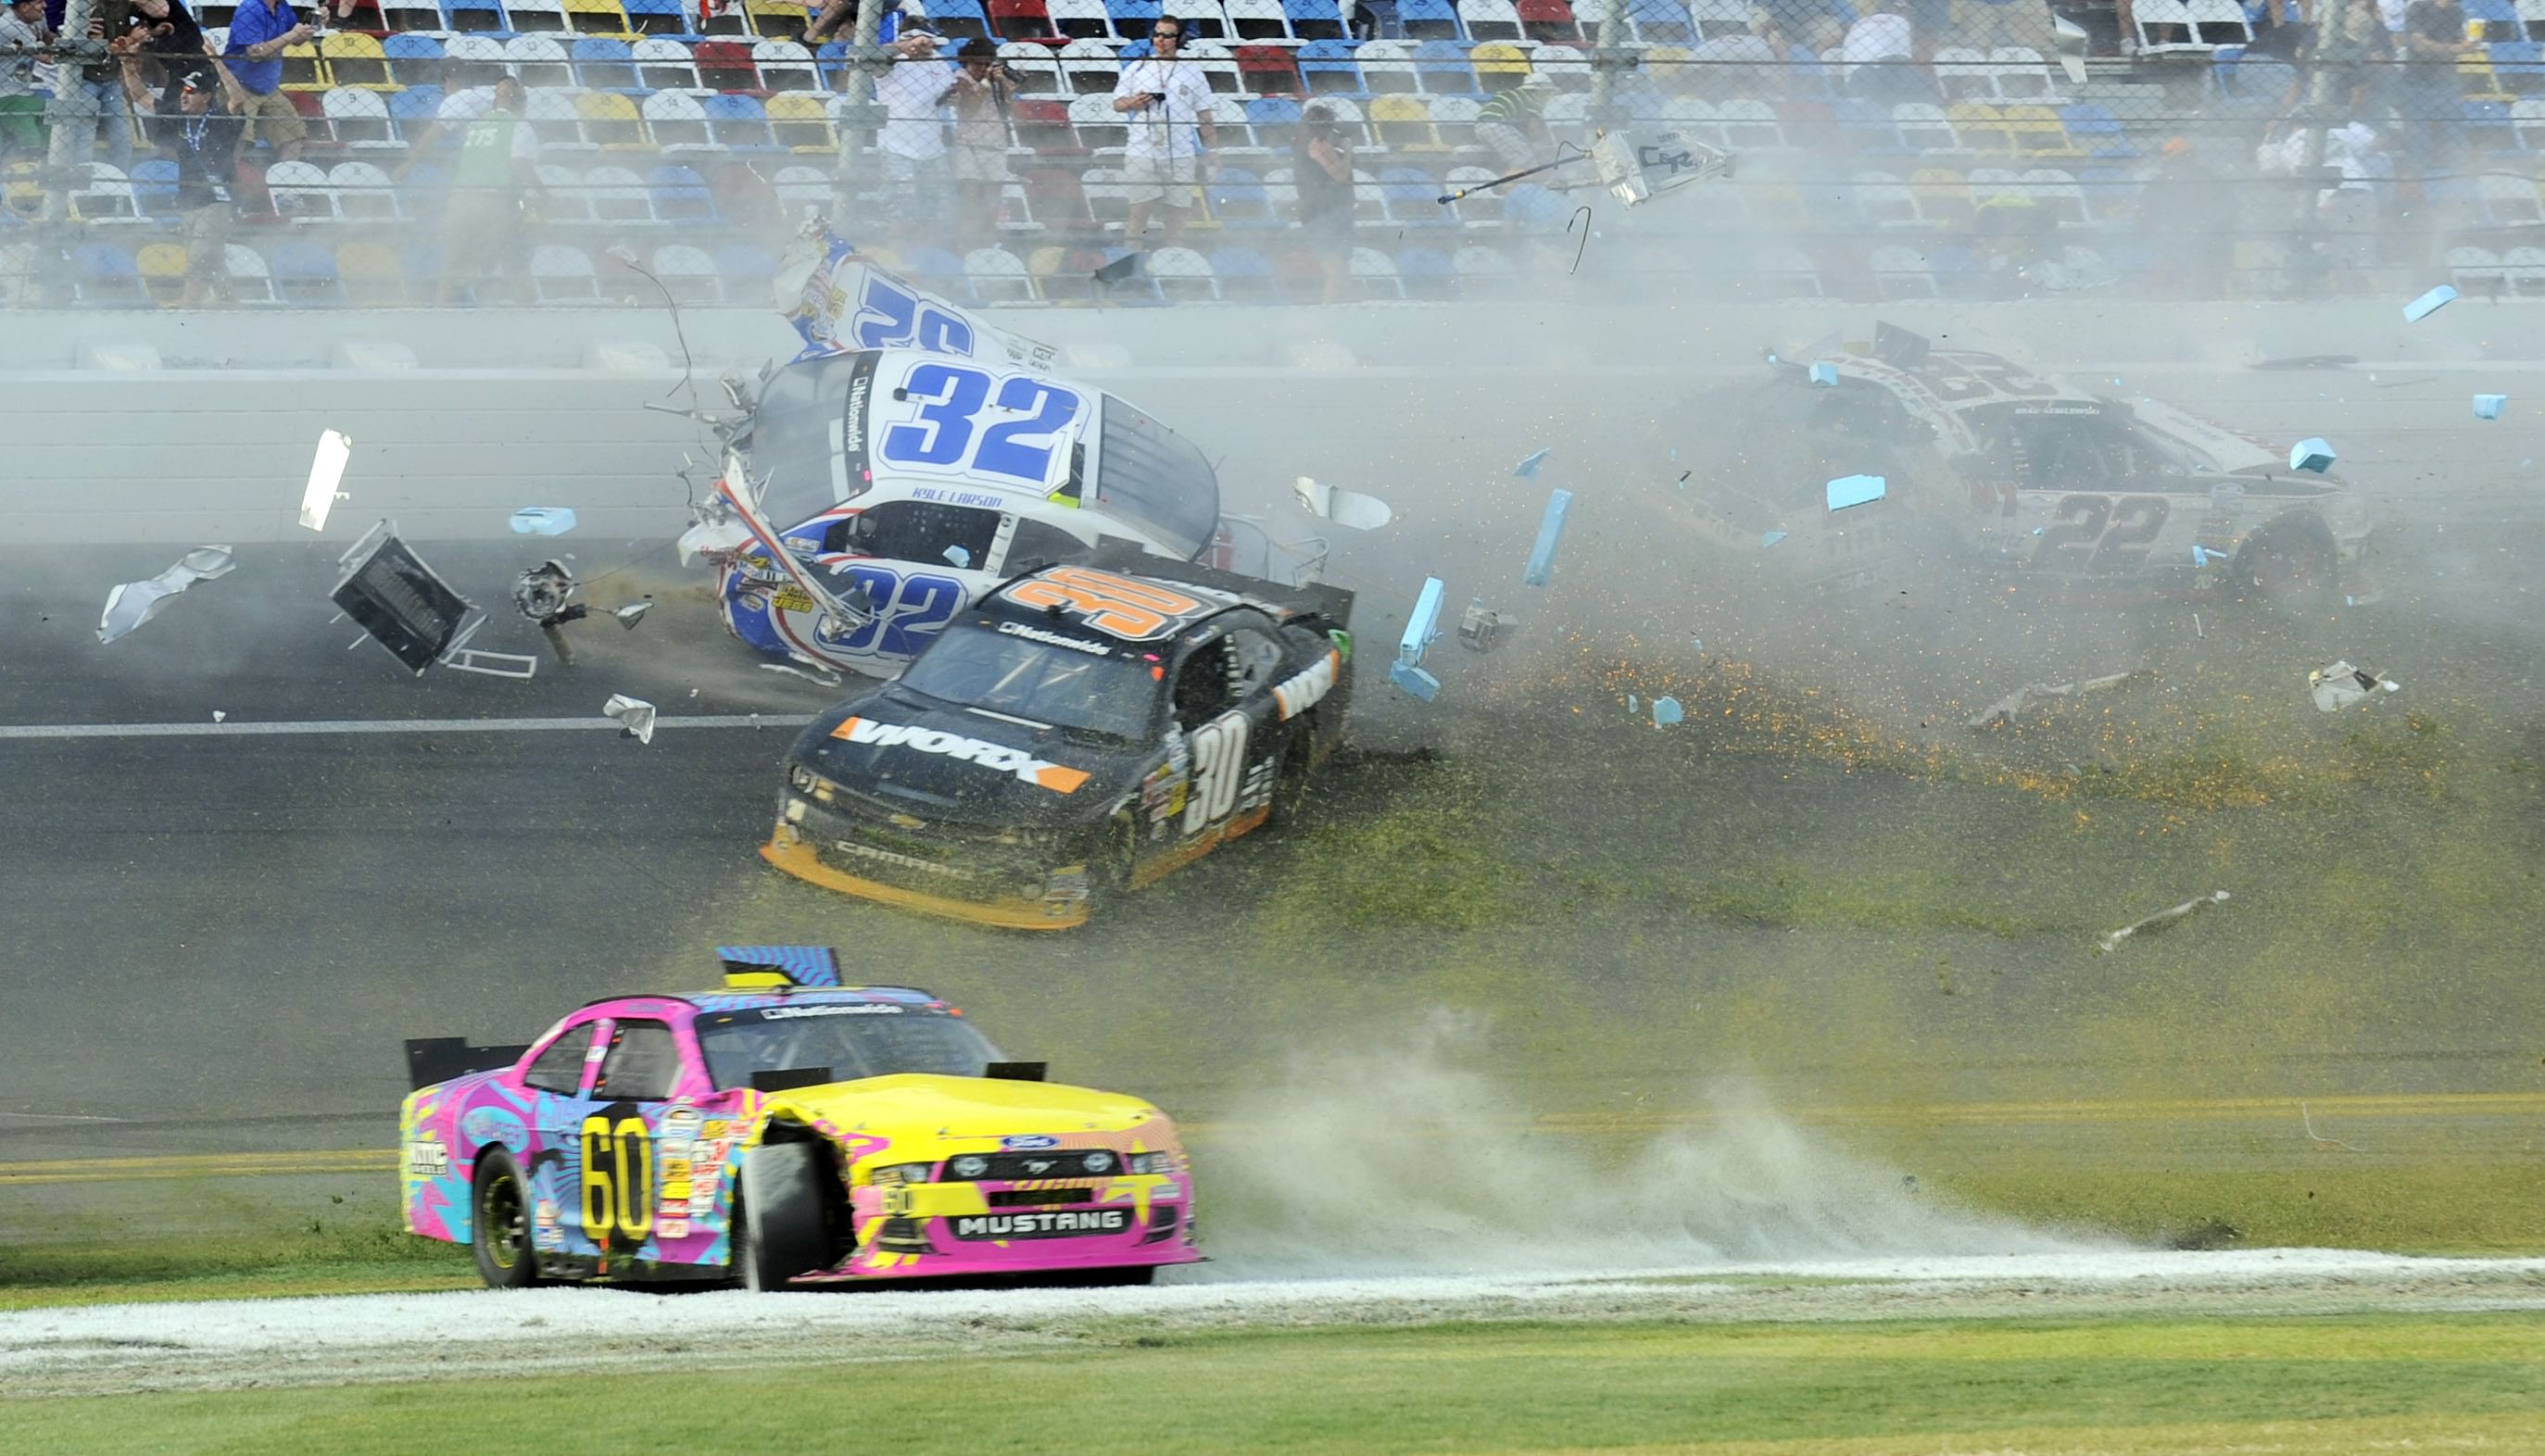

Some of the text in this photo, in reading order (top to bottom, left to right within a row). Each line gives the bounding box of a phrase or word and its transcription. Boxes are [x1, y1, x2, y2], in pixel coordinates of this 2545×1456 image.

[349, 94, 357, 104] 9
[847, 384, 867, 452] Nationwide
[884, 364, 1080, 482] 32
[912, 487, 1002, 508] KYLE LARSON
[2031, 494, 2171, 572] 22
[1005, 565, 1208, 640] 30
[1013, 624, 1112, 656] Nationwide
[850, 717, 1060, 785] WORX
[1183, 711, 1248, 834] 30
[783, 1004, 904, 1018] Nationwide
[1008, 1136, 1049, 1148] Ford
[580, 1115, 653, 1240] 60
[958, 1211, 1124, 1236] MUSTANG
